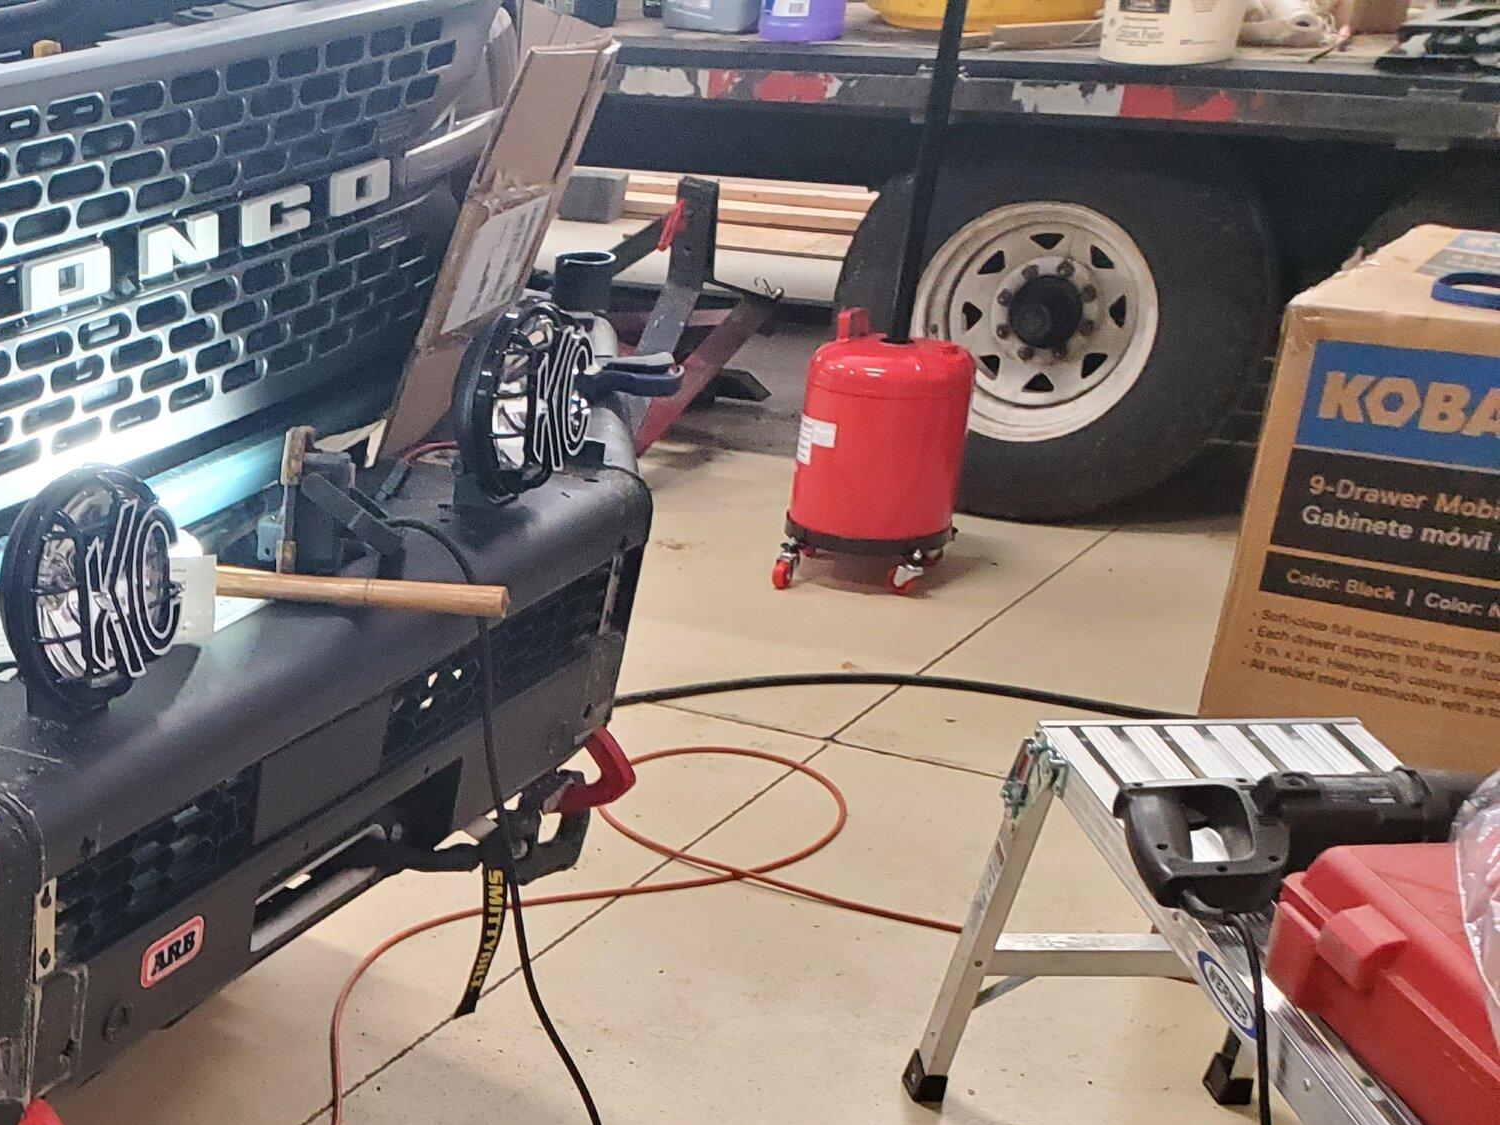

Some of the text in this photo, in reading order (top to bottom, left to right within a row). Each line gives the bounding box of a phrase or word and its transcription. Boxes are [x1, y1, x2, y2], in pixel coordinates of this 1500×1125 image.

[1318, 370, 1500, 437] KOBA
[1308, 474, 1429, 510] 9-Drawer
[1302, 504, 1493, 551] Gabinete móvil
[84, 498, 183, 678] KC
[1287, 568, 1340, 592] Color:
[1344, 579, 1396, 600] Black
[1424, 591, 1483, 616] Color:
[151, 930, 196, 977] ARB
